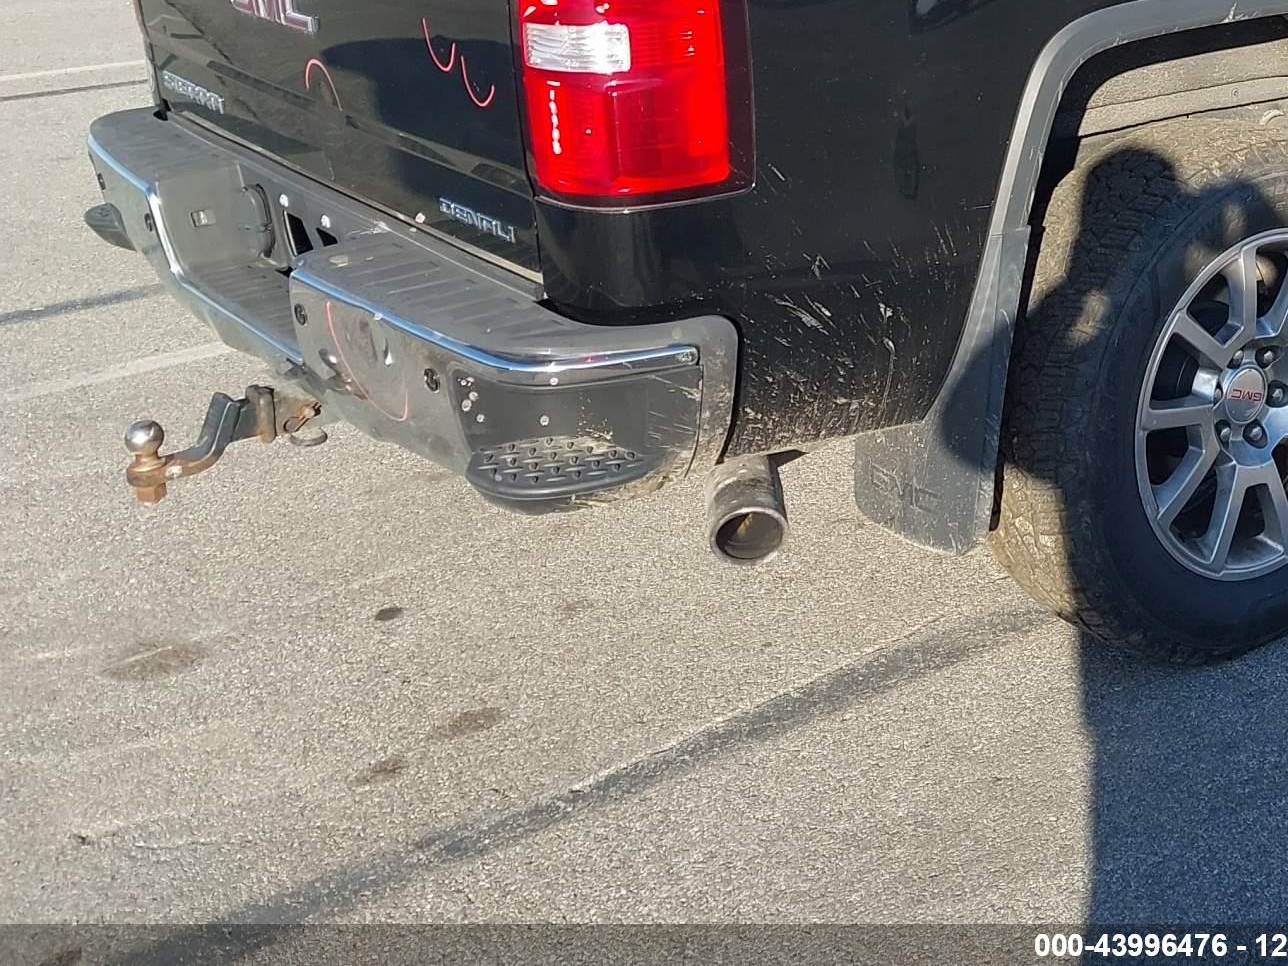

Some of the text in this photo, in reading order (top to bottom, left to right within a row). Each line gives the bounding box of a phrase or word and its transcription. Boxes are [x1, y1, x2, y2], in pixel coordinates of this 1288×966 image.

[162, 70, 224, 115] SIERRA
[439, 197, 517, 244] DENALI
[1230, 387, 1263, 402] GMC
